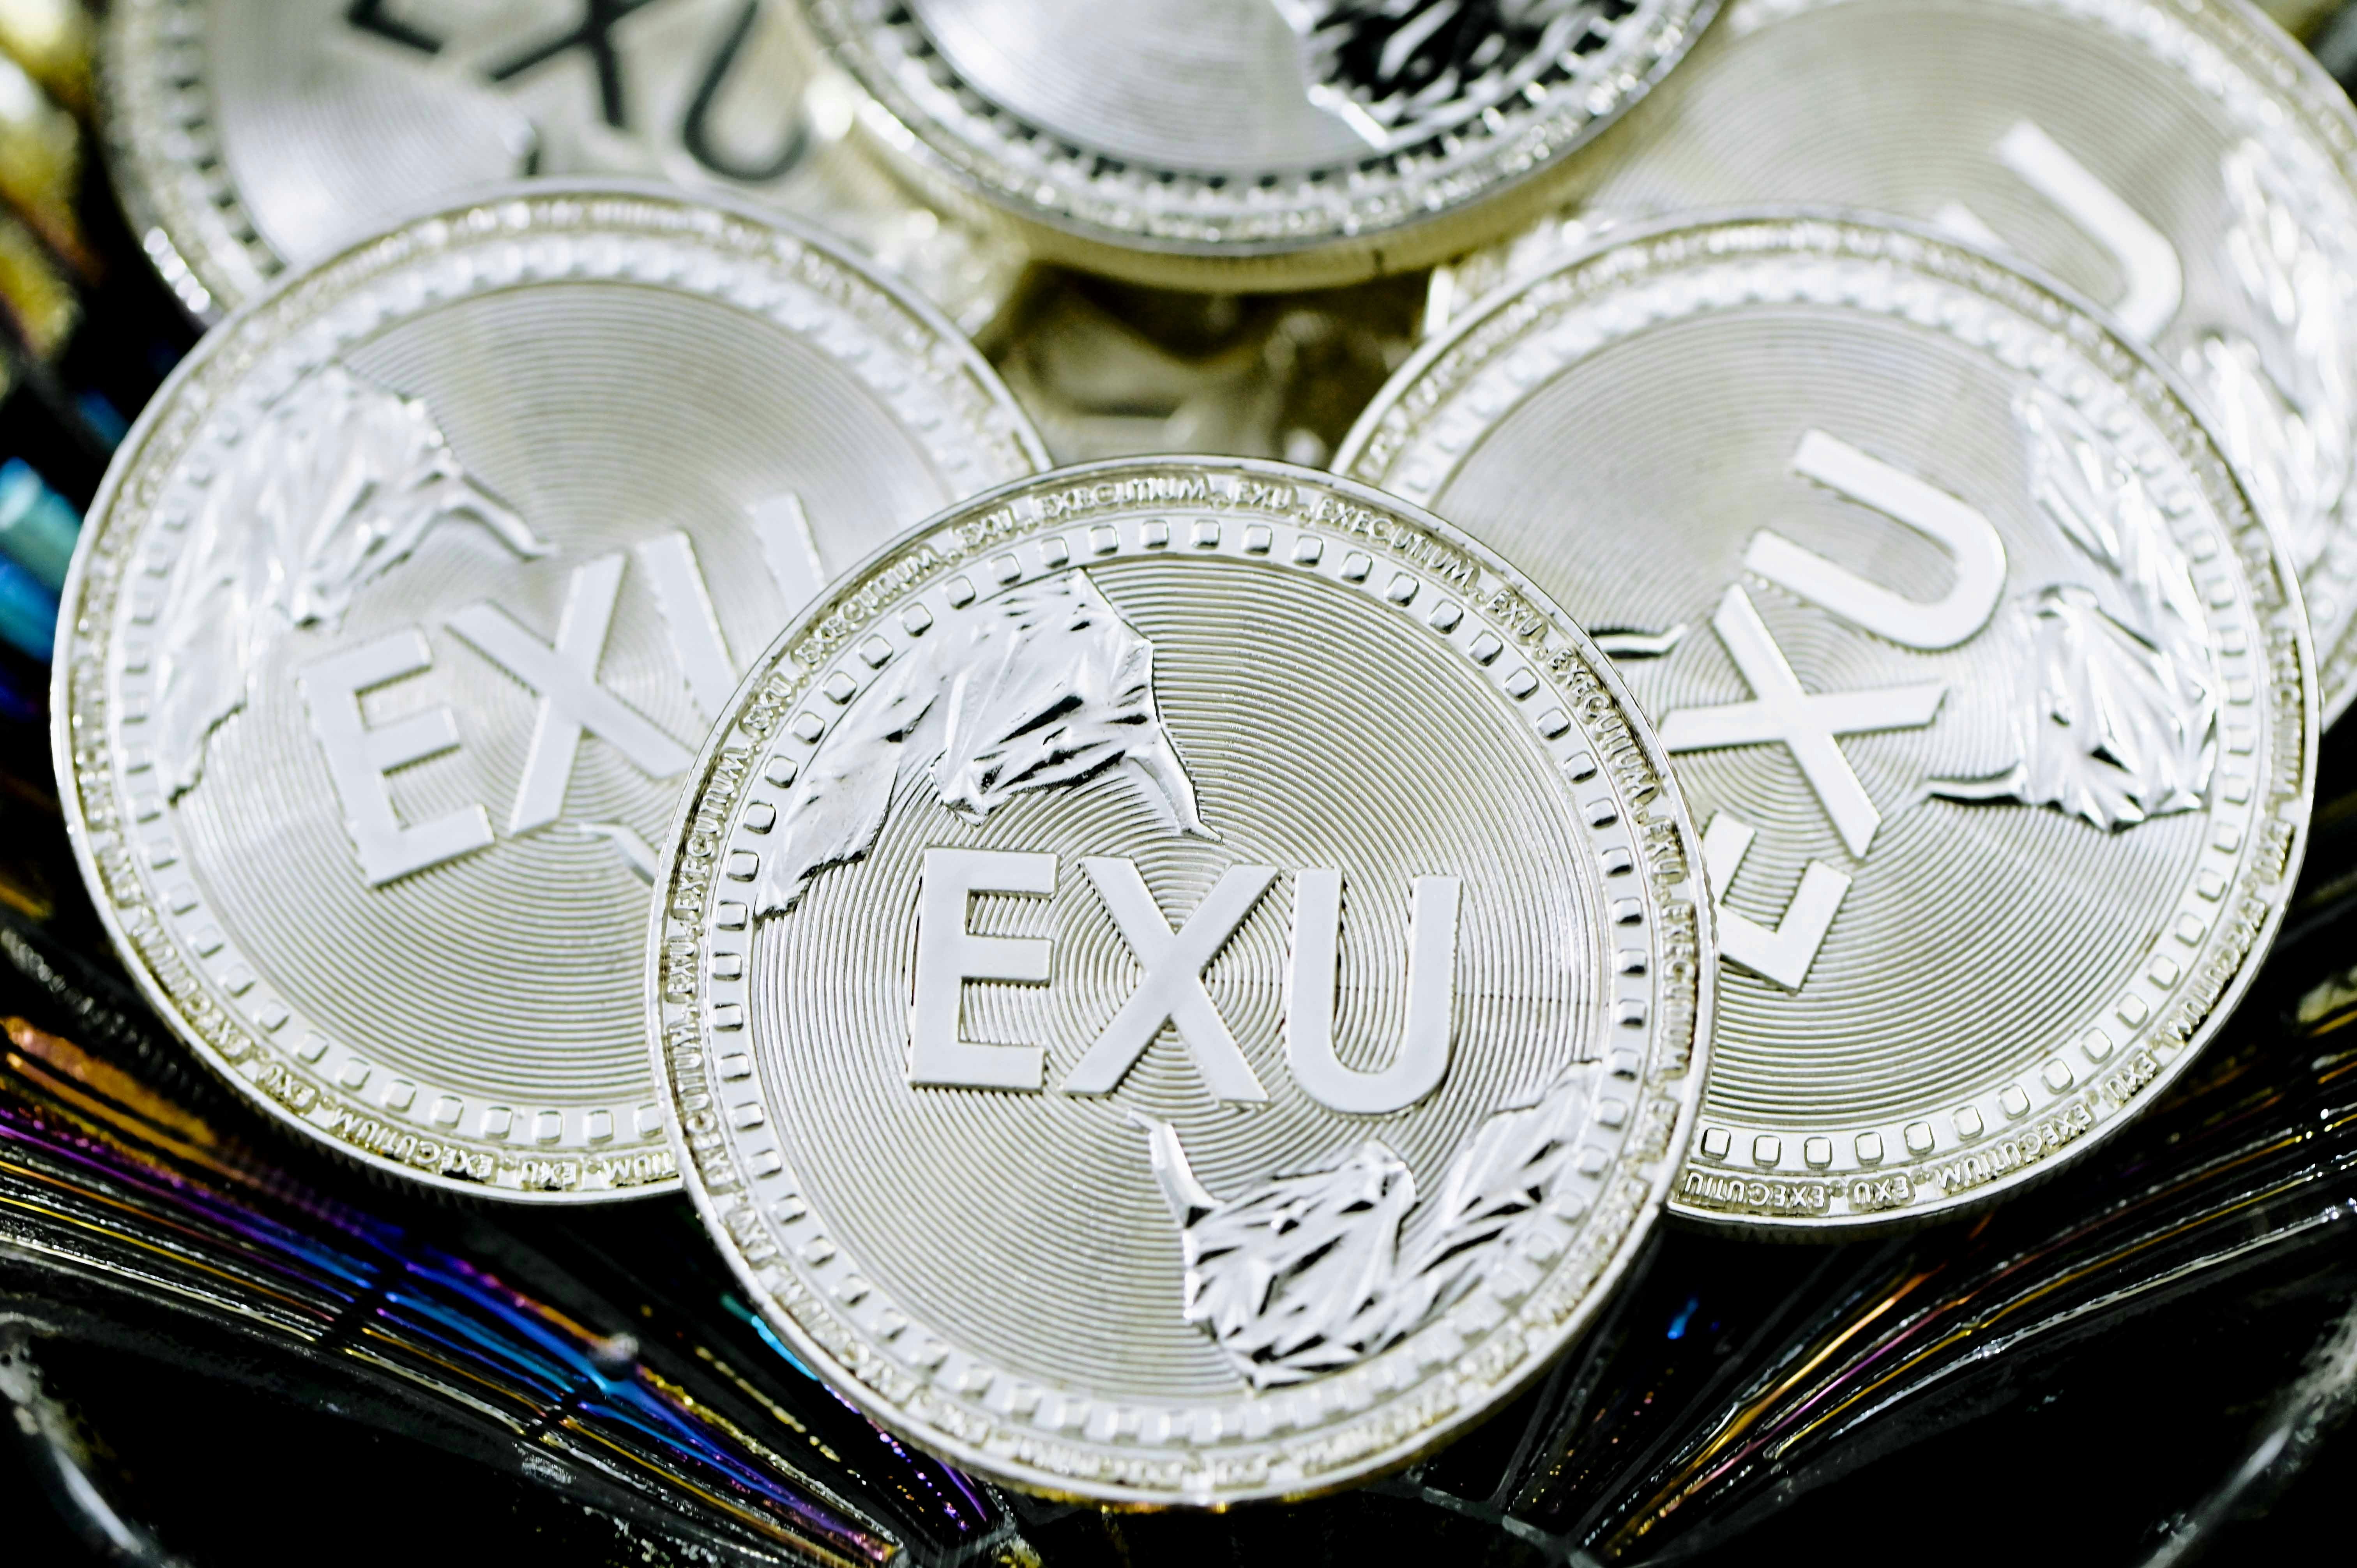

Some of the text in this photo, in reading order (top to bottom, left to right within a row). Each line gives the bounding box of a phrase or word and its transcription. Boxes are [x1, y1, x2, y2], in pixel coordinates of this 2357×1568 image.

[1035, 473, 1207, 520] EXECUTIUM
[1235, 479, 1294, 510] EXU
[954, 504, 1018, 551] EXU
[1316, 495, 1478, 587] EXECUTIUM
[793, 541, 941, 669] EXECUTIUM
[1488, 586, 1544, 639] EXU
[741, 673, 795, 735] EXU
[1546, 643, 1656, 800] EXECUTIUM
[1661, 429, 2007, 994] EXU
[673, 740, 754, 914] EXECUTIUM
[1643, 816, 1685, 878] EXU
[667, 938, 695, 995] EXU
[909, 846, 1463, 1114] EXU
[2159, 894, 2269, 1047] EXECUTIUM
[257, 1059, 317, 1111] EXU
[2102, 1049, 2159, 1104] EXU
[329, 1104, 494, 1180] EXECUTIUM
[519, 1159, 576, 1184] EXU
[1933, 1101, 2094, 1191] EXECUTIUM
[1683, 1169, 1825, 1207] EXECUTIU
[1852, 1174, 1910, 1205] EXU
